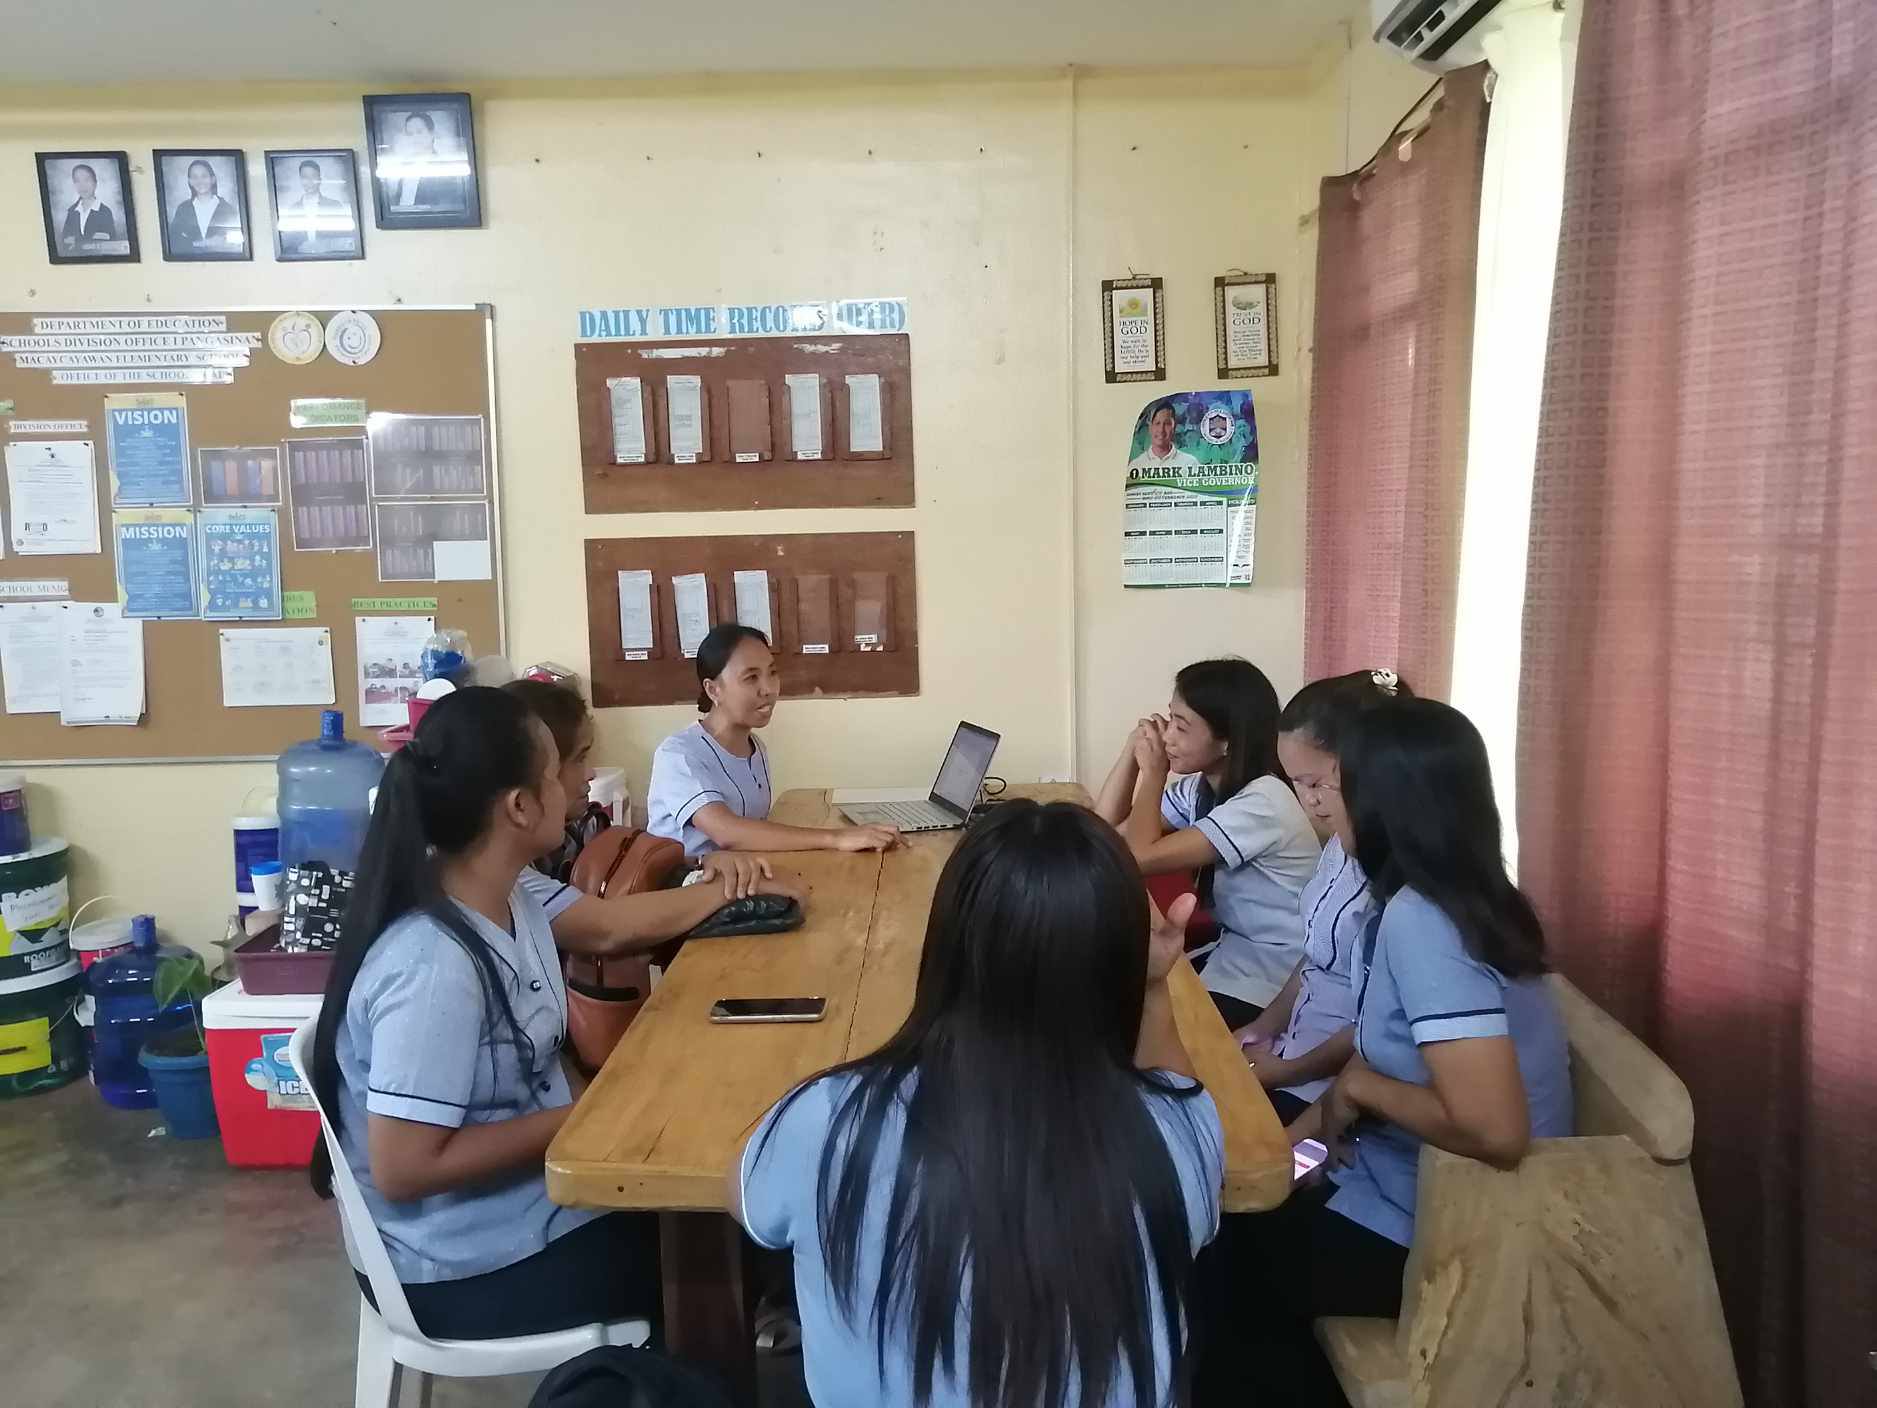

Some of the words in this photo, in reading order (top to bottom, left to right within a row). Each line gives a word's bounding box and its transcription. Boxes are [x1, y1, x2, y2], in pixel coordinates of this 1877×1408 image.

[40, 319, 123, 330] DEPARTMENT
[127, 319, 141, 329] OF
[147, 318, 220, 329] EDUCATION
[579, 310, 650, 337] DAILY
[659, 308, 716, 335] TIME
[728, 304, 826, 334] RECO
[1232, 316, 1261, 326] GOD
[1121, 326, 1148, 335] GOD
[64, 337, 121, 347] DIVISION
[125, 336, 170, 346] OFFICE
[114, 409, 177, 425] VISION
[1141, 466, 1182, 479] MARK
[1187, 464, 1254, 478] LAMBINO
[1176, 478, 1199, 487] VICE
[1202, 476, 1254, 486] GOVERNOR
[121, 526, 187, 539] MISSION
[206, 525, 231, 534] CORE
[232, 525, 271, 534] VALUES
